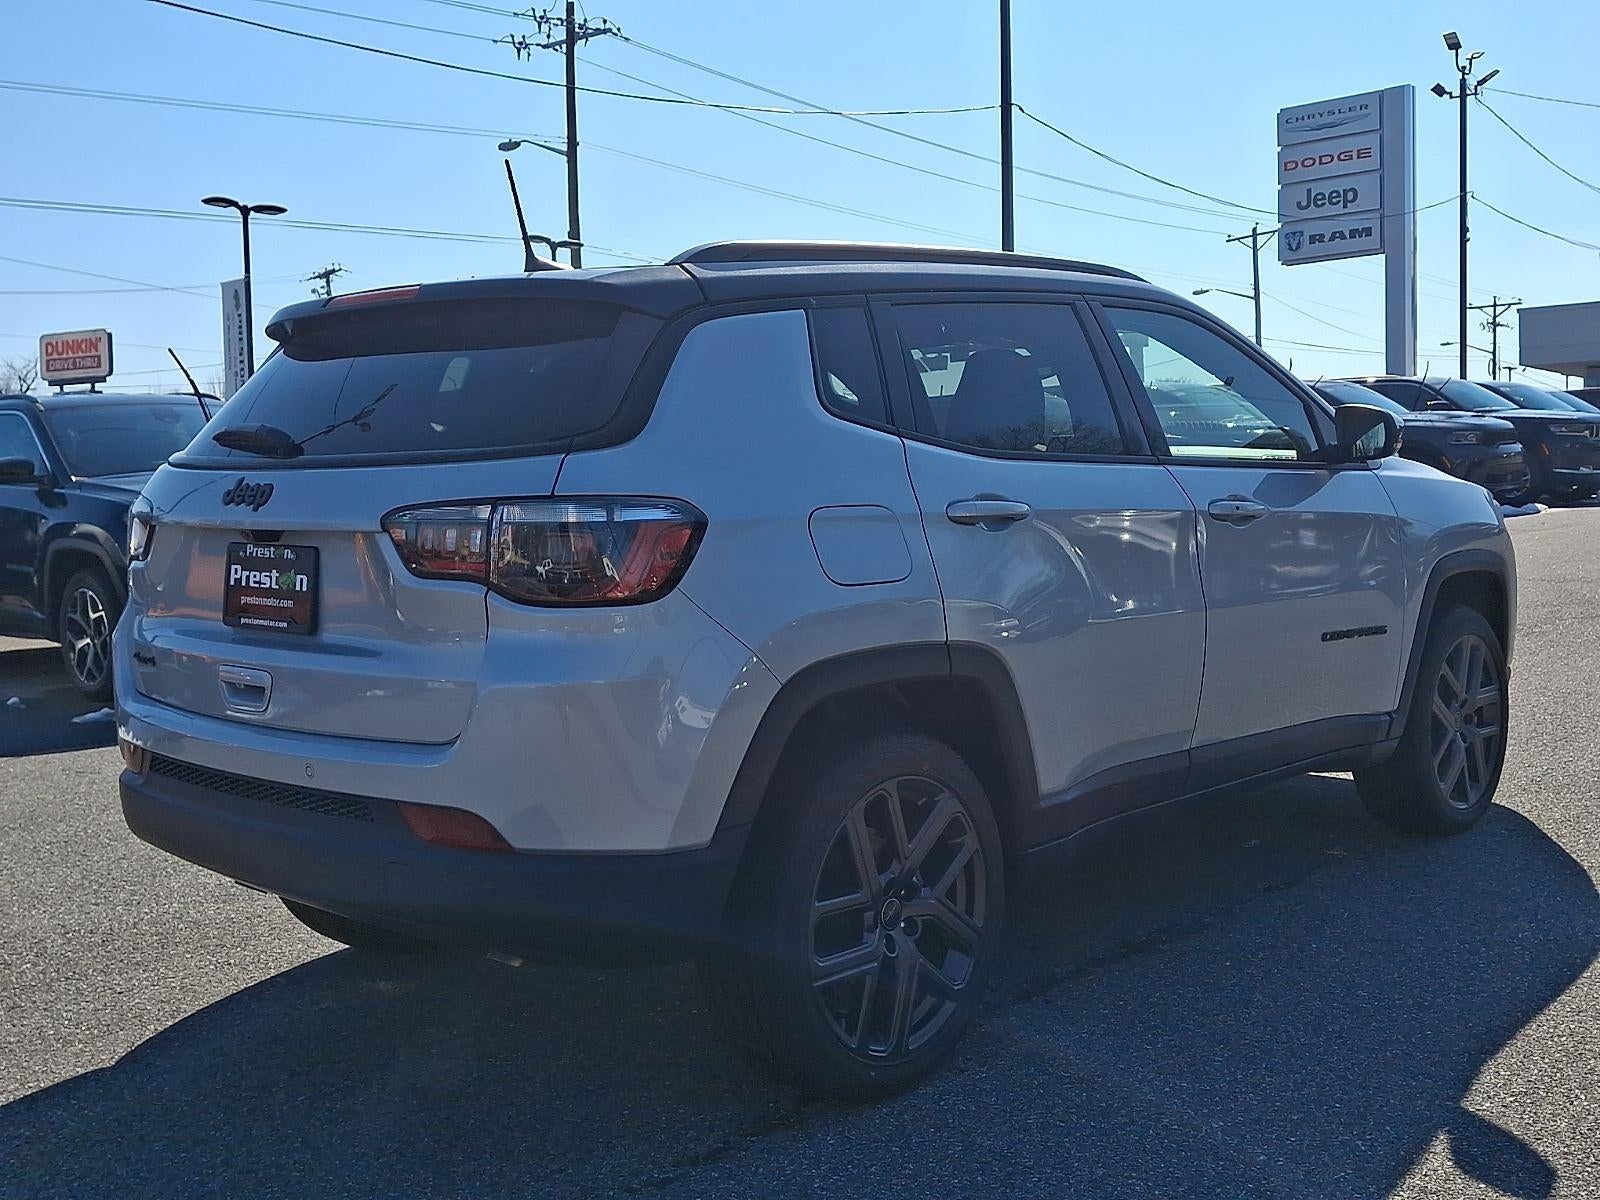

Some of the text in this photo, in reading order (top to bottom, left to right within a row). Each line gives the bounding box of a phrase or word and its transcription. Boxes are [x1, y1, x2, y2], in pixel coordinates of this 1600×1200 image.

[1285, 103, 1369, 124] CHRYSLER
[1283, 147, 1372, 172] DODGE
[1296, 187, 1359, 210] Jeep
[1308, 226, 1373, 245] RAM
[45, 336, 102, 357] DUNKIN'
[222, 476, 275, 512] Jeep
[229, 564, 309, 592] Preston
[240, 595, 294, 608] prestonmotor.com
[240, 617, 288, 629] prestonmotor.com
